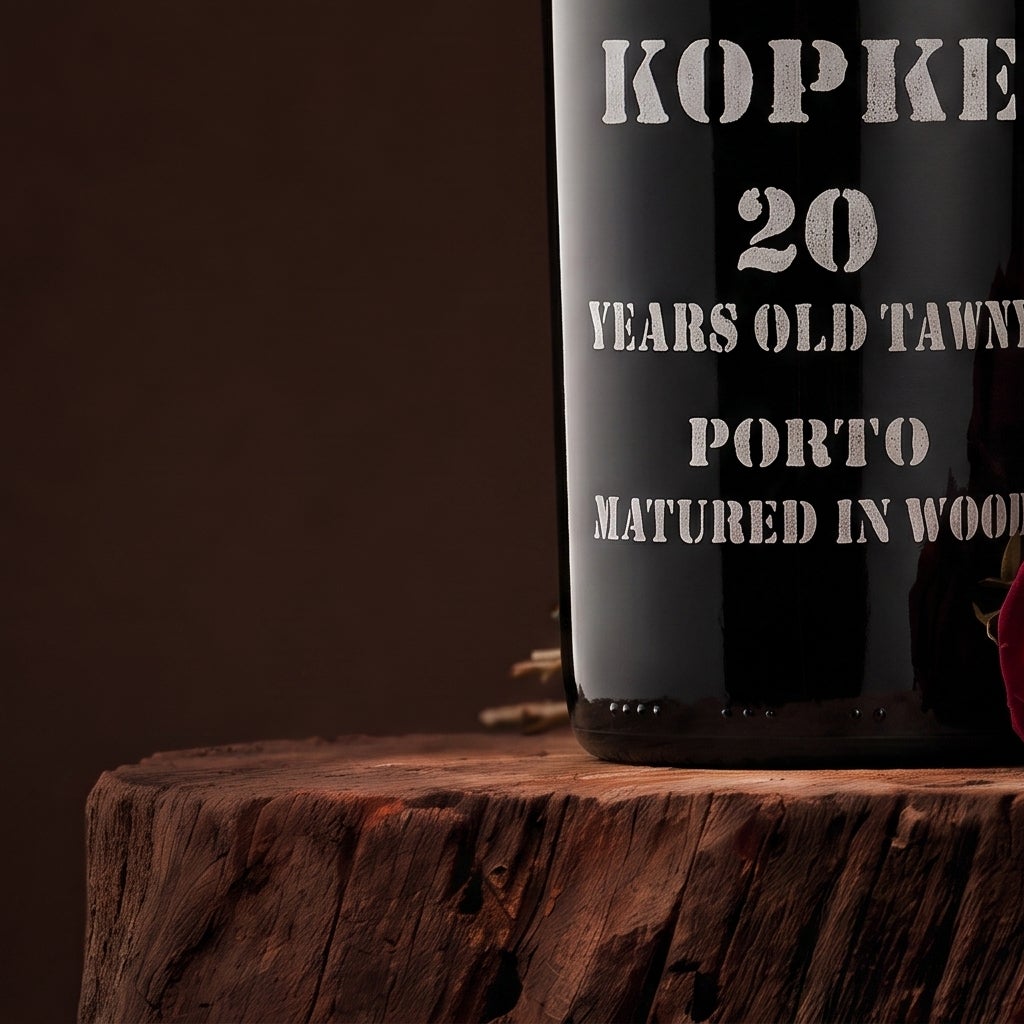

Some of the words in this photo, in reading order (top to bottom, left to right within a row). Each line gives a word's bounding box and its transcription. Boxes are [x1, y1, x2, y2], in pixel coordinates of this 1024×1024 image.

[601, 38, 1017, 124] KOPKE
[736, 187, 879, 274] 20
[588, 301, 739, 354] YEARS
[753, 303, 868, 354] OLD
[688, 417, 930, 468] PORTO
[593, 494, 818, 545] MATURED
[836, 498, 891, 545] IN
